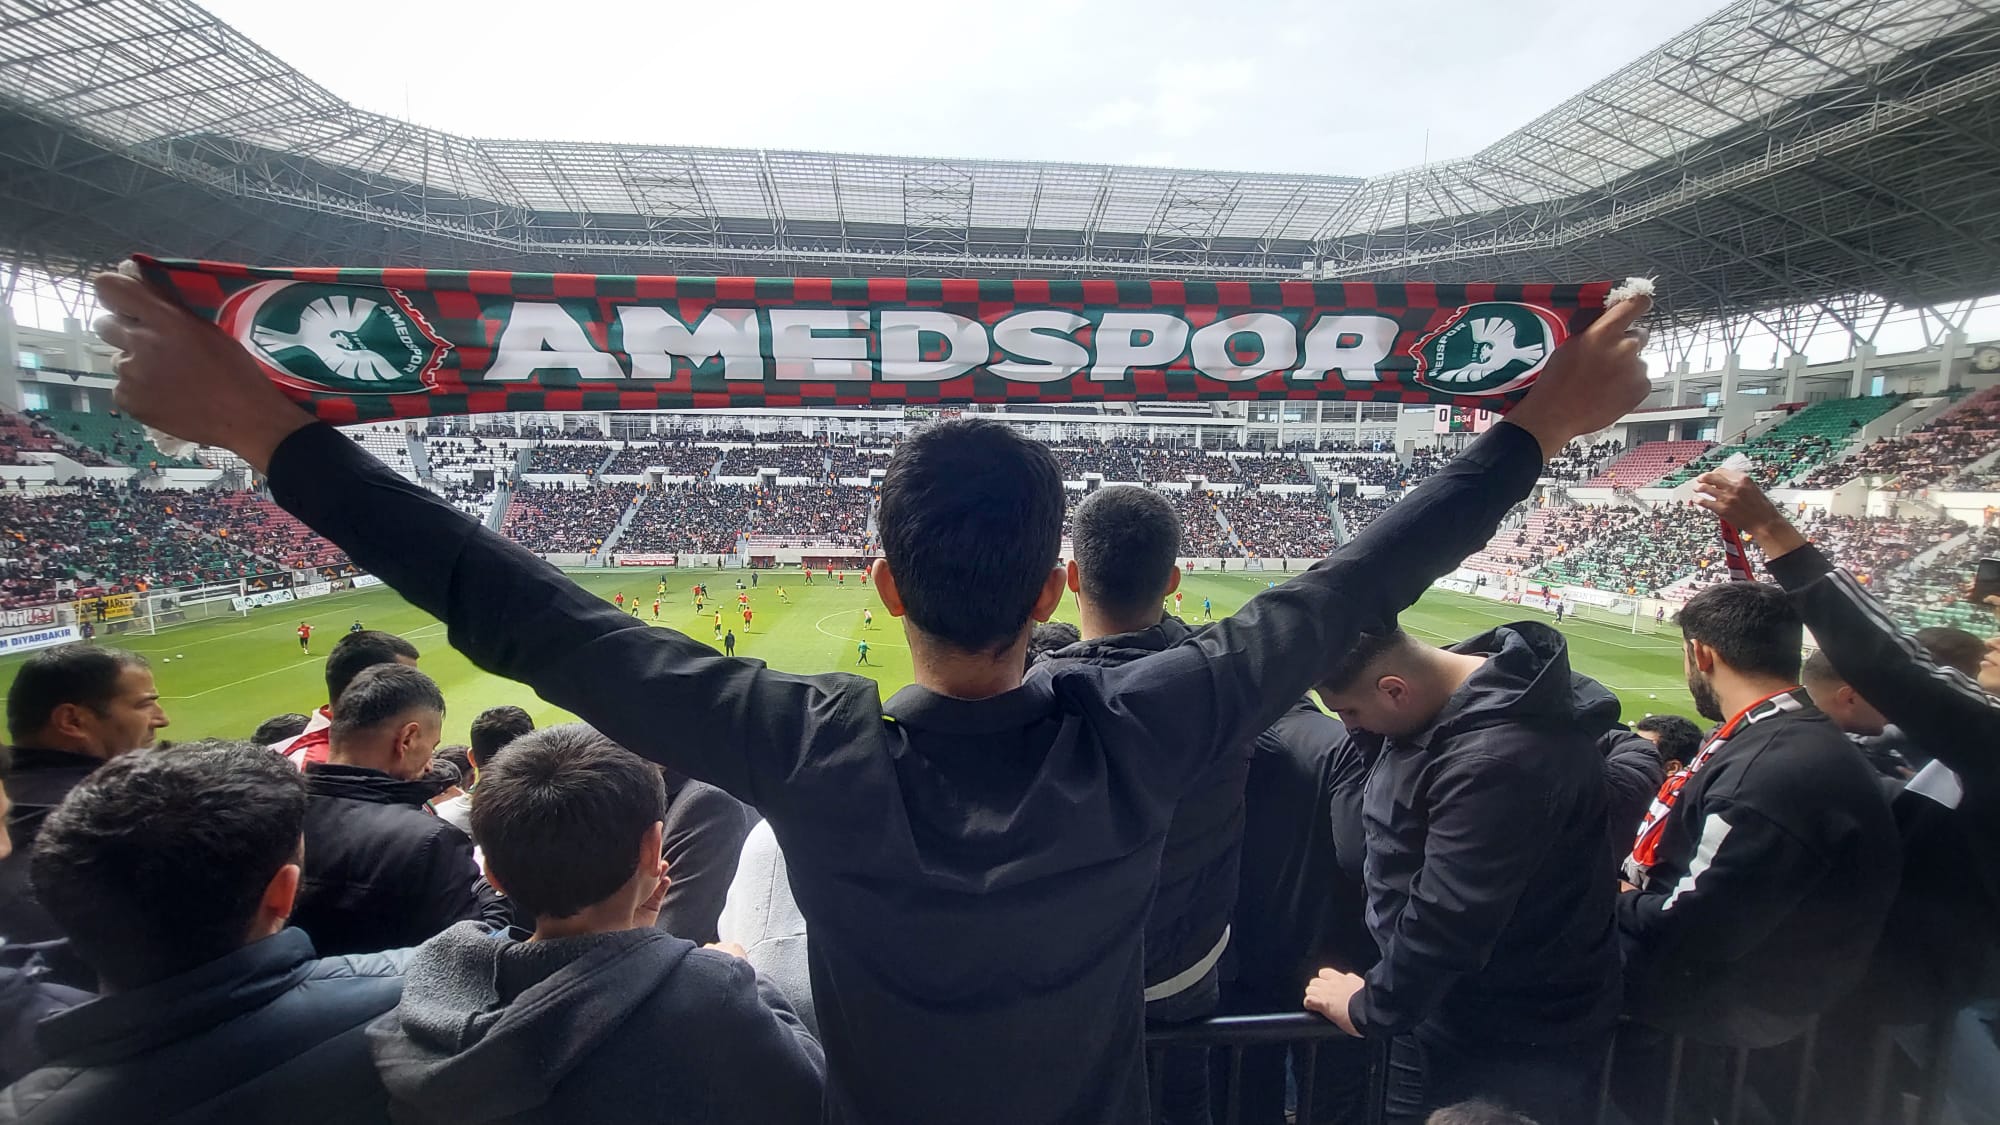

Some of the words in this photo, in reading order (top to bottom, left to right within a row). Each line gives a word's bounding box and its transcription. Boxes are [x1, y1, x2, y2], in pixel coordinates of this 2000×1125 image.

[380, 304, 423, 374] AMEDSPOR
[481, 301, 1402, 384] AMEDSPOR
[1439, 408, 1448, 422] 0
